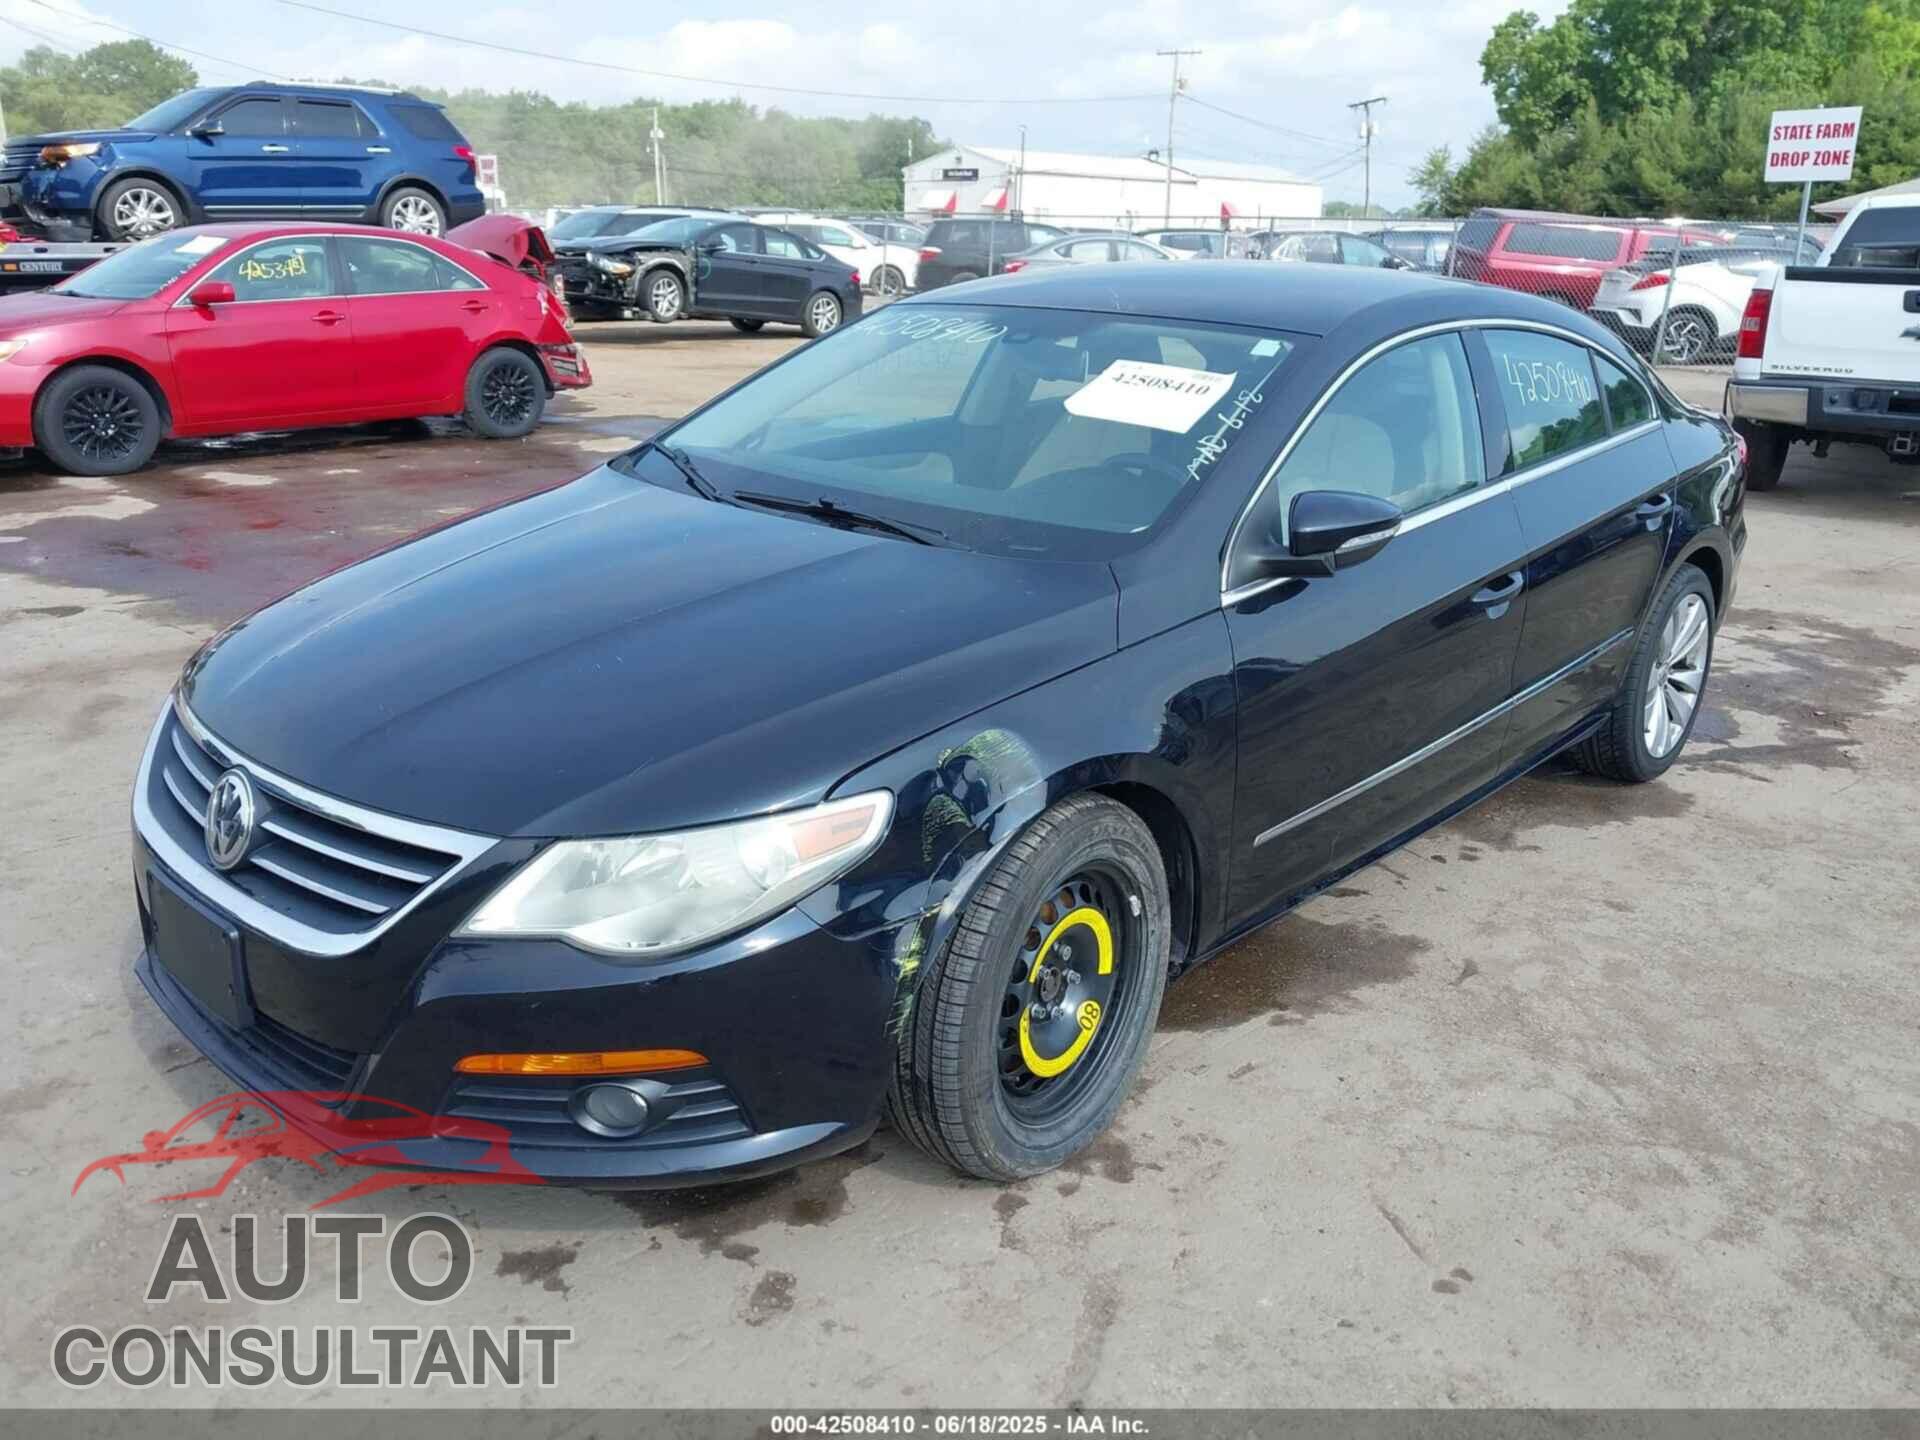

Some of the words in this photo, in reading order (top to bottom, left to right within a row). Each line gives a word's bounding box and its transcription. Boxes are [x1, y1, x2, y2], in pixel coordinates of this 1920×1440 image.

[1773, 124, 1813, 141] STATE
[1816, 122, 1856, 139] FARM
[1770, 151, 1810, 167] DROP
[1813, 149, 1851, 166] ZONE
[1112, 371, 1211, 397] 42508410
[1080, 1003, 1099, 1031] 80
